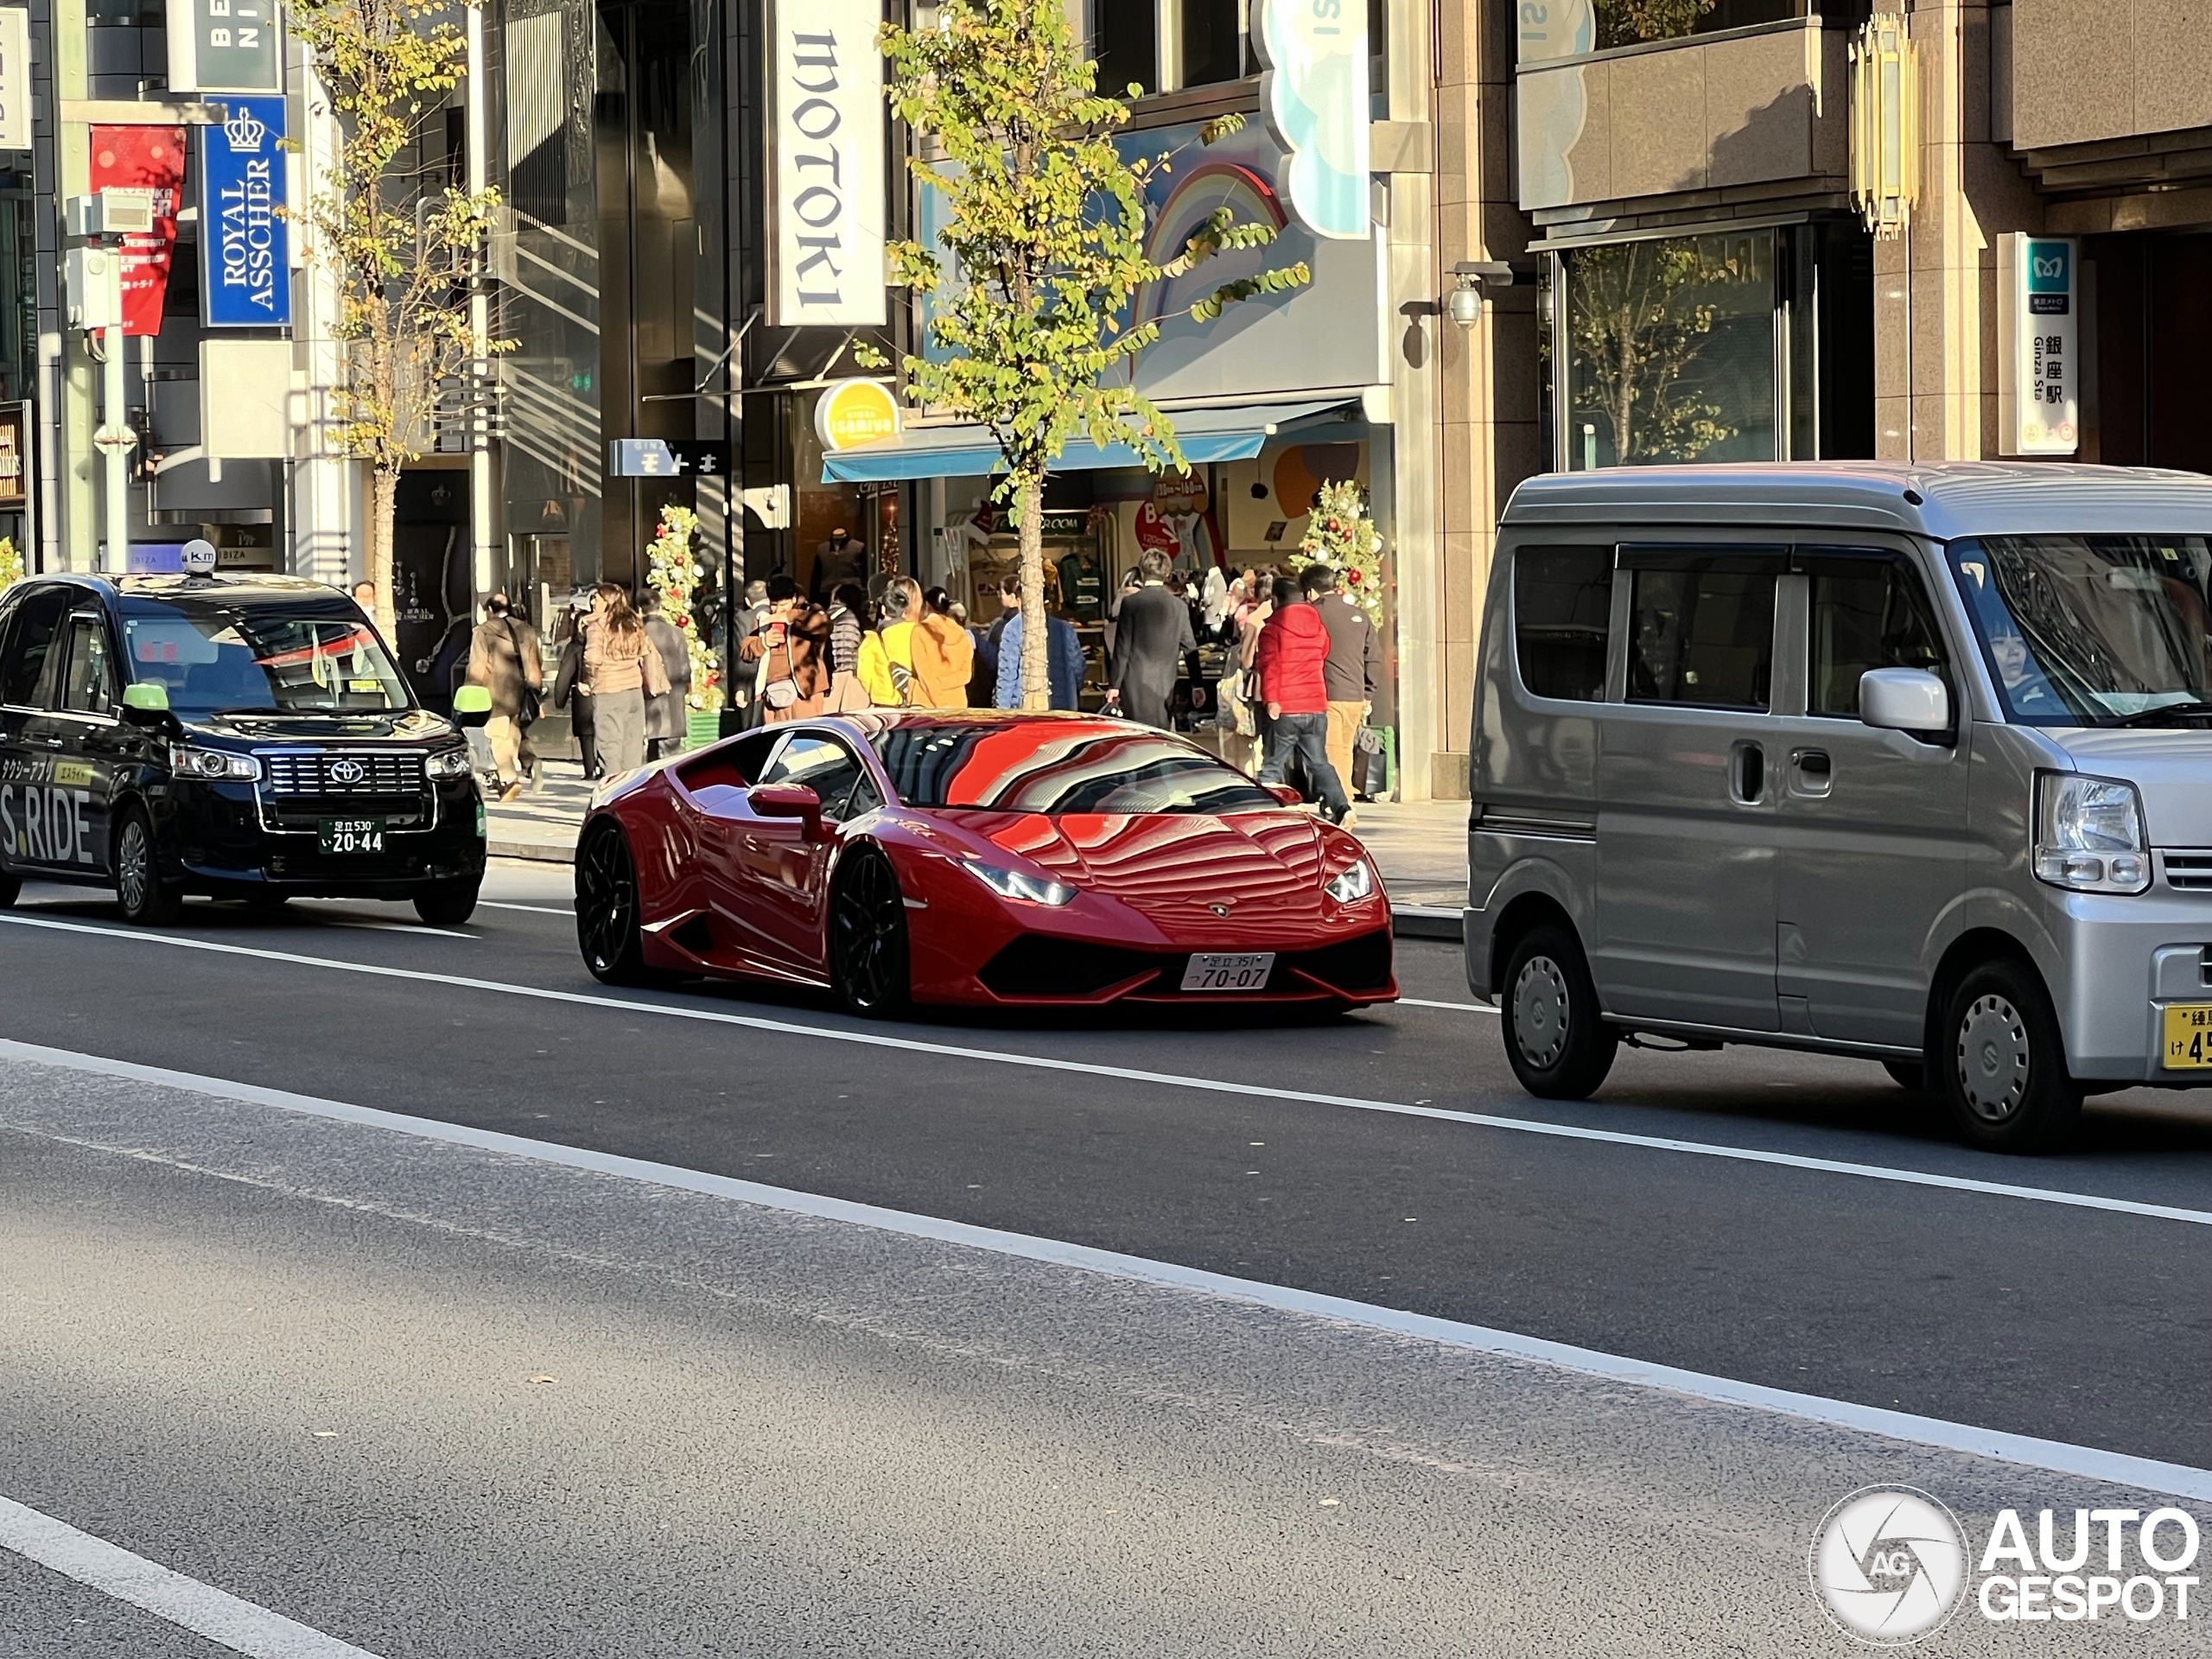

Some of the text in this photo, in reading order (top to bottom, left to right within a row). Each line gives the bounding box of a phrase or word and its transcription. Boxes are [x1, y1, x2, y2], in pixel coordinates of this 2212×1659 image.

[791, 29, 842, 308] MOTOKI
[221, 179, 247, 287] ROYAL
[247, 158, 273, 311] ASSCHER
[2034, 336, 2044, 375] Ginza
[2046, 336, 2063, 404] 銀座駅
[633, 442, 675, 450] GINZA
[641, 453, 717, 474] モトキ
[333, 832, 383, 852] 20-44
[1201, 969, 1267, 988] 70-07
[2171, 1041, 2183, 1056] け
